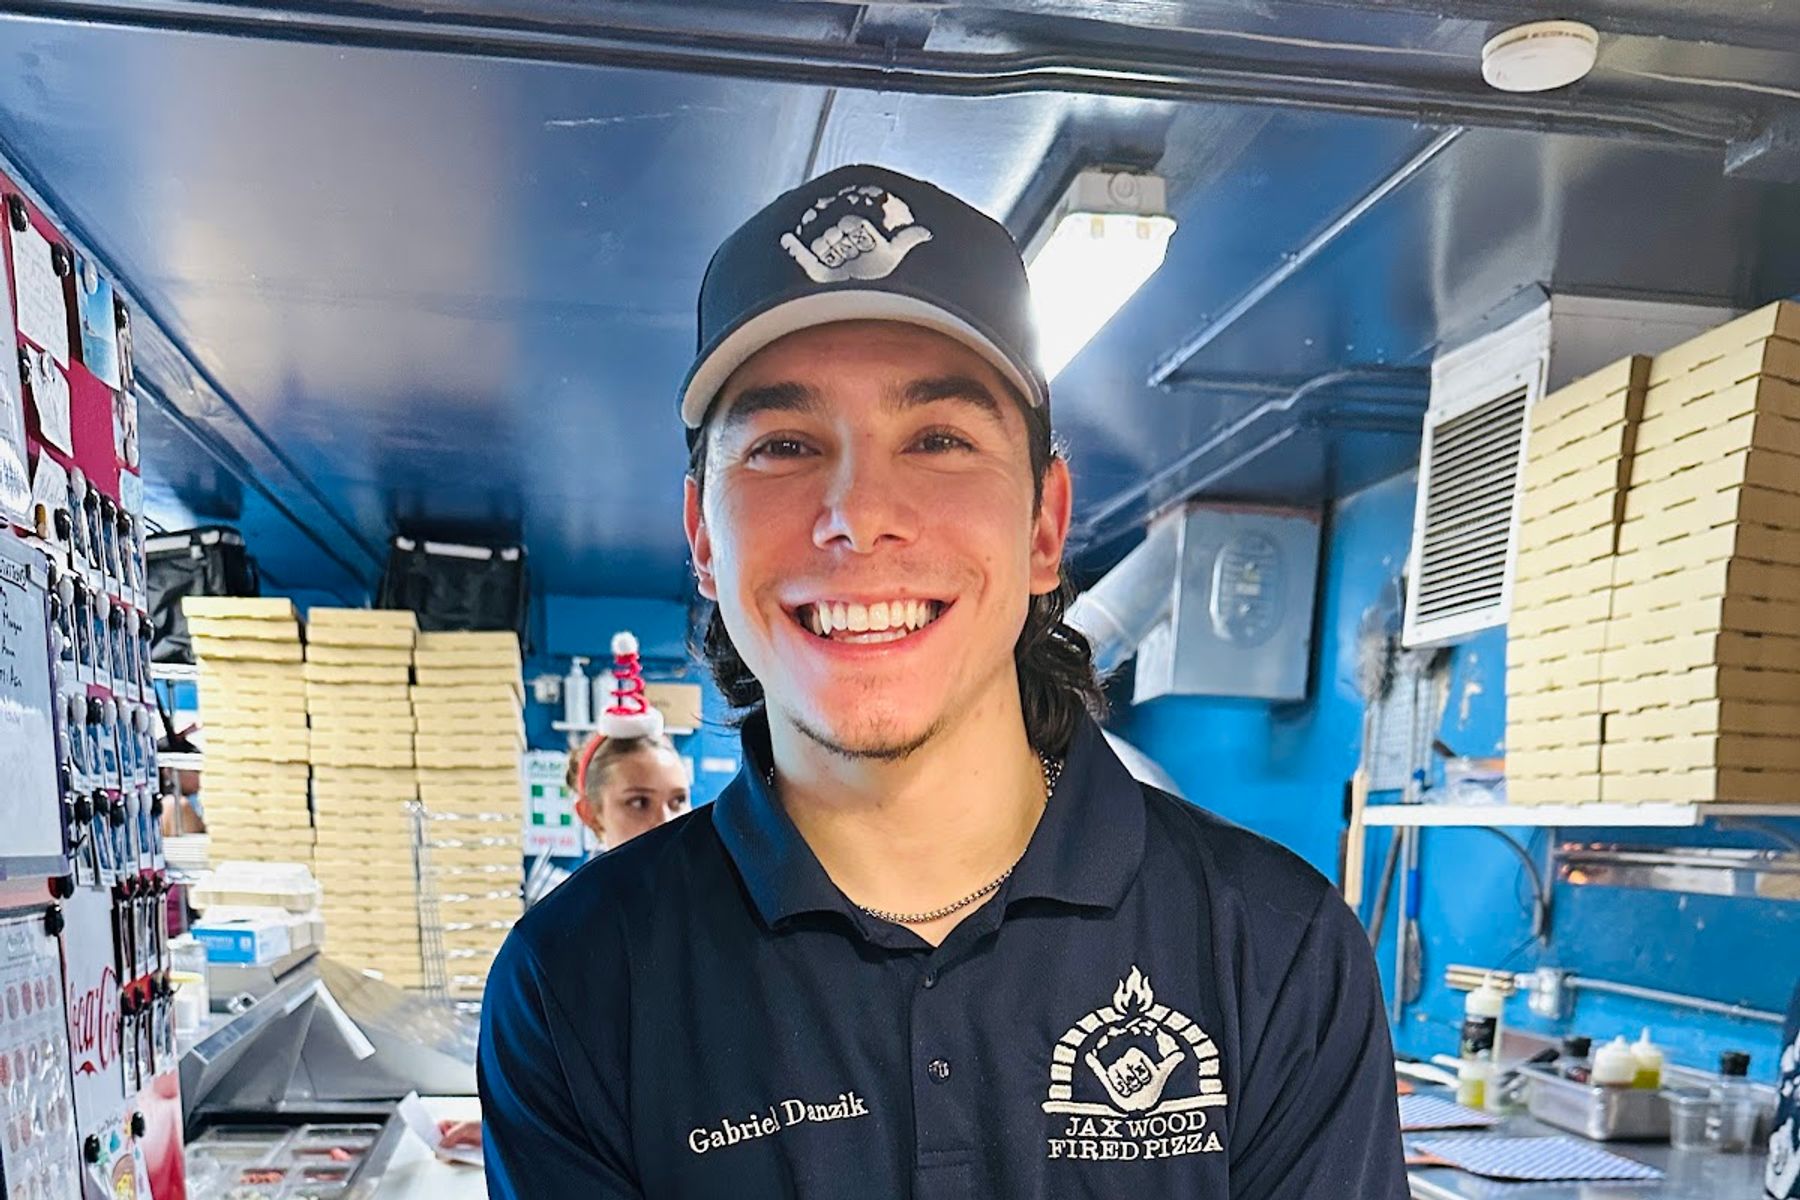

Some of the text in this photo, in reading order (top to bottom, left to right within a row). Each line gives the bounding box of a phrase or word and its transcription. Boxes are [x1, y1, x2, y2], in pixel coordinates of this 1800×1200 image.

[688, 1091, 869, 1154] Gabriel Danzik
[1065, 1112, 1206, 1137] JAX WOOD
[1048, 1132, 1223, 1160] FIRED PIZZA
